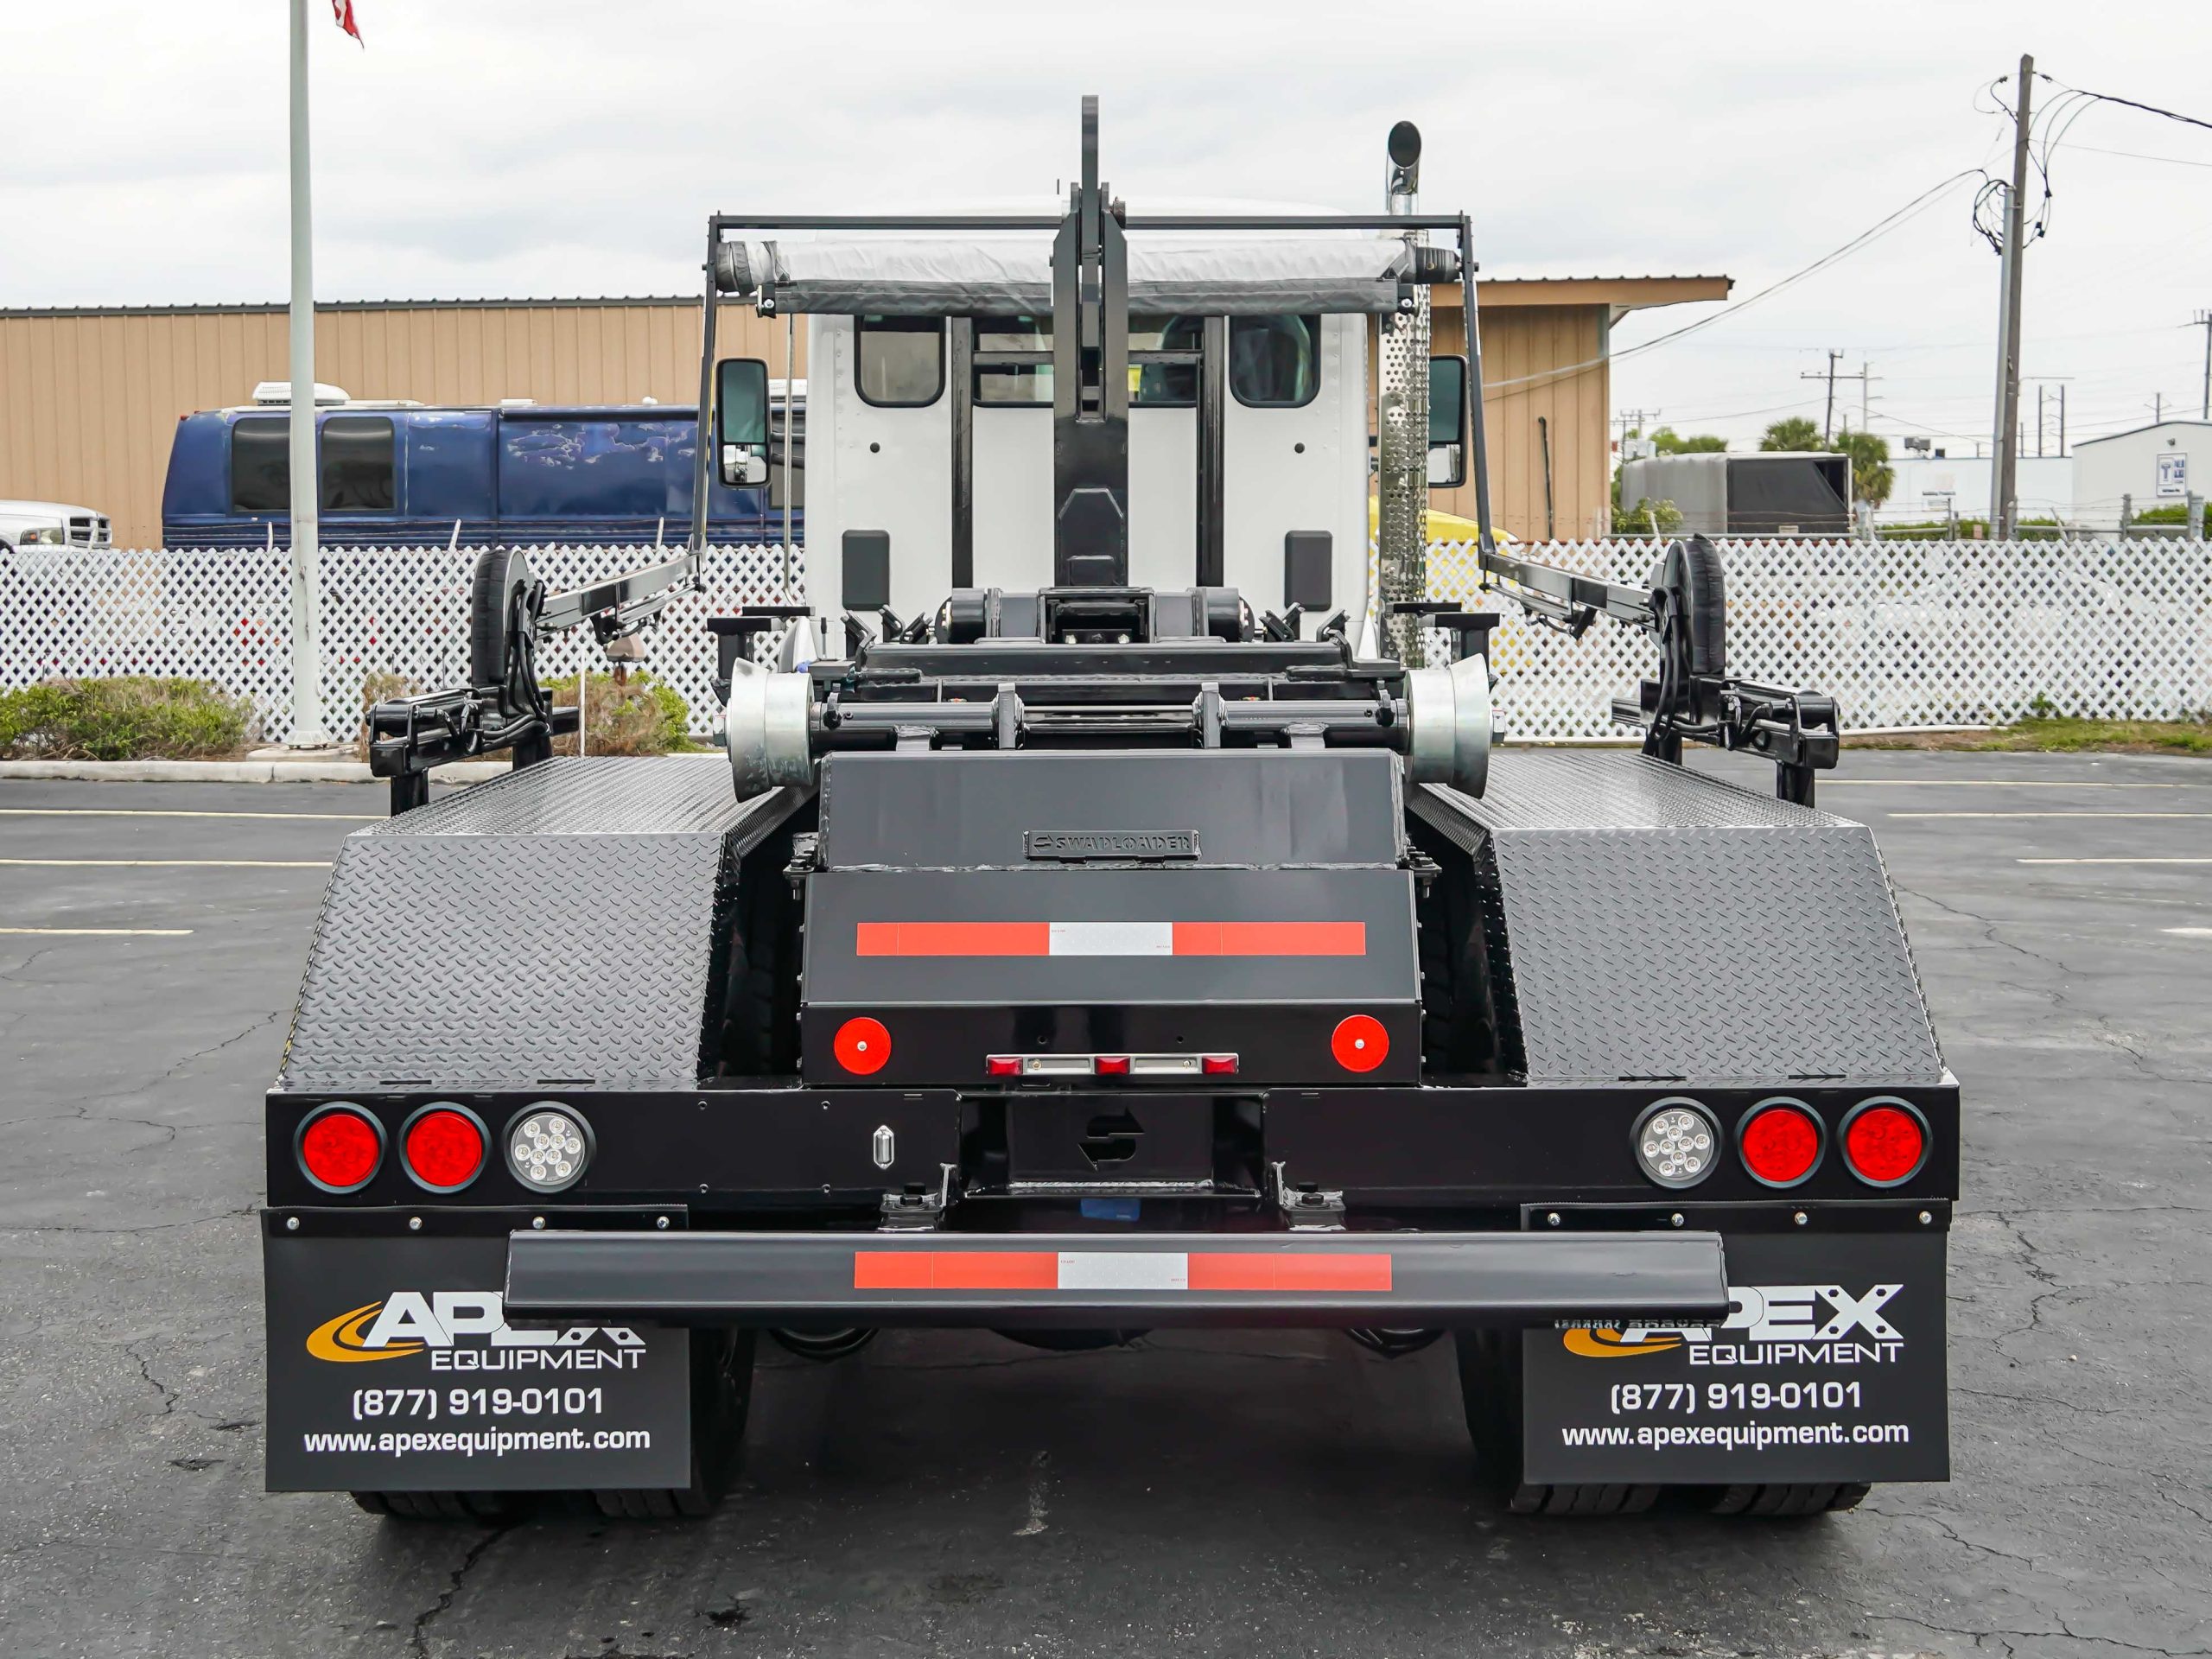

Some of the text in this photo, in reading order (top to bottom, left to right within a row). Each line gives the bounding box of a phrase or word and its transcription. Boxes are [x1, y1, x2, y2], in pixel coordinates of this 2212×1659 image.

[1056, 836, 1190, 852] SWAPLOADER
[431, 1349, 646, 1370] EQUIPMENT
[1690, 1343, 1904, 1365] EQUIPMENT
[353, 1387, 602, 1421] (877) 919-0101
[1611, 1381, 1860, 1414] (877) 919-0101
[304, 1426, 651, 1458] www.apexequipment.com
[1562, 1420, 1910, 1452] www.apexequipment.com
